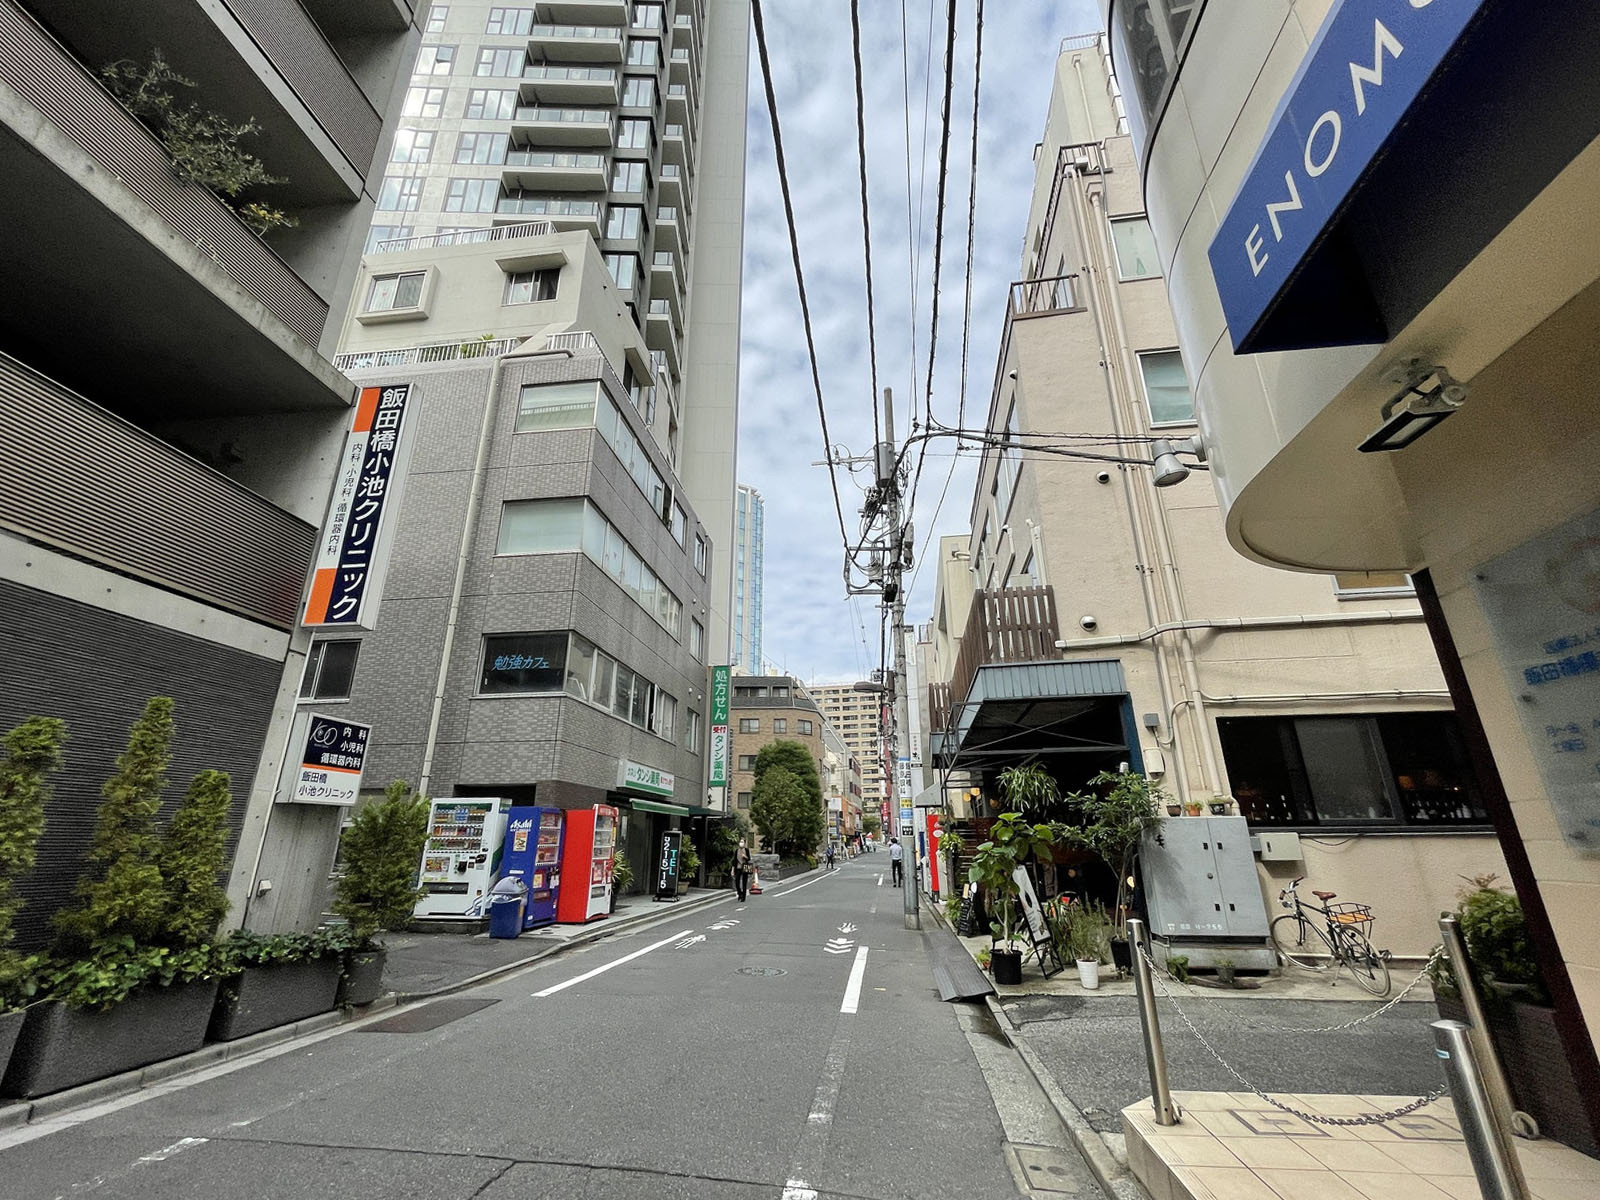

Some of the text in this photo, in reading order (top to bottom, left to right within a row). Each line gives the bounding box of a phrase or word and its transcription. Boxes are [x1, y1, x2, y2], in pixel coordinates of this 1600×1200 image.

[1245, 0, 1434, 277] ENOM
[332, 388, 407, 620] 飯田橋小池クリニック
[491, 654, 550, 671] 勉強カフェ
[714, 670, 728, 721] 処方せん
[340, 741, 364, 754] 小児科
[320, 752, 361, 768] 循環器内科
[713, 735, 725, 780] タンシ薬局
[301, 771, 328, 784] 飯田橋
[636, 768, 660, 787] タンシ薬局
[299, 786, 354, 799] 小池クリニック
[510, 818, 533, 830] Asahi
[669, 849, 678, 876] TEL
